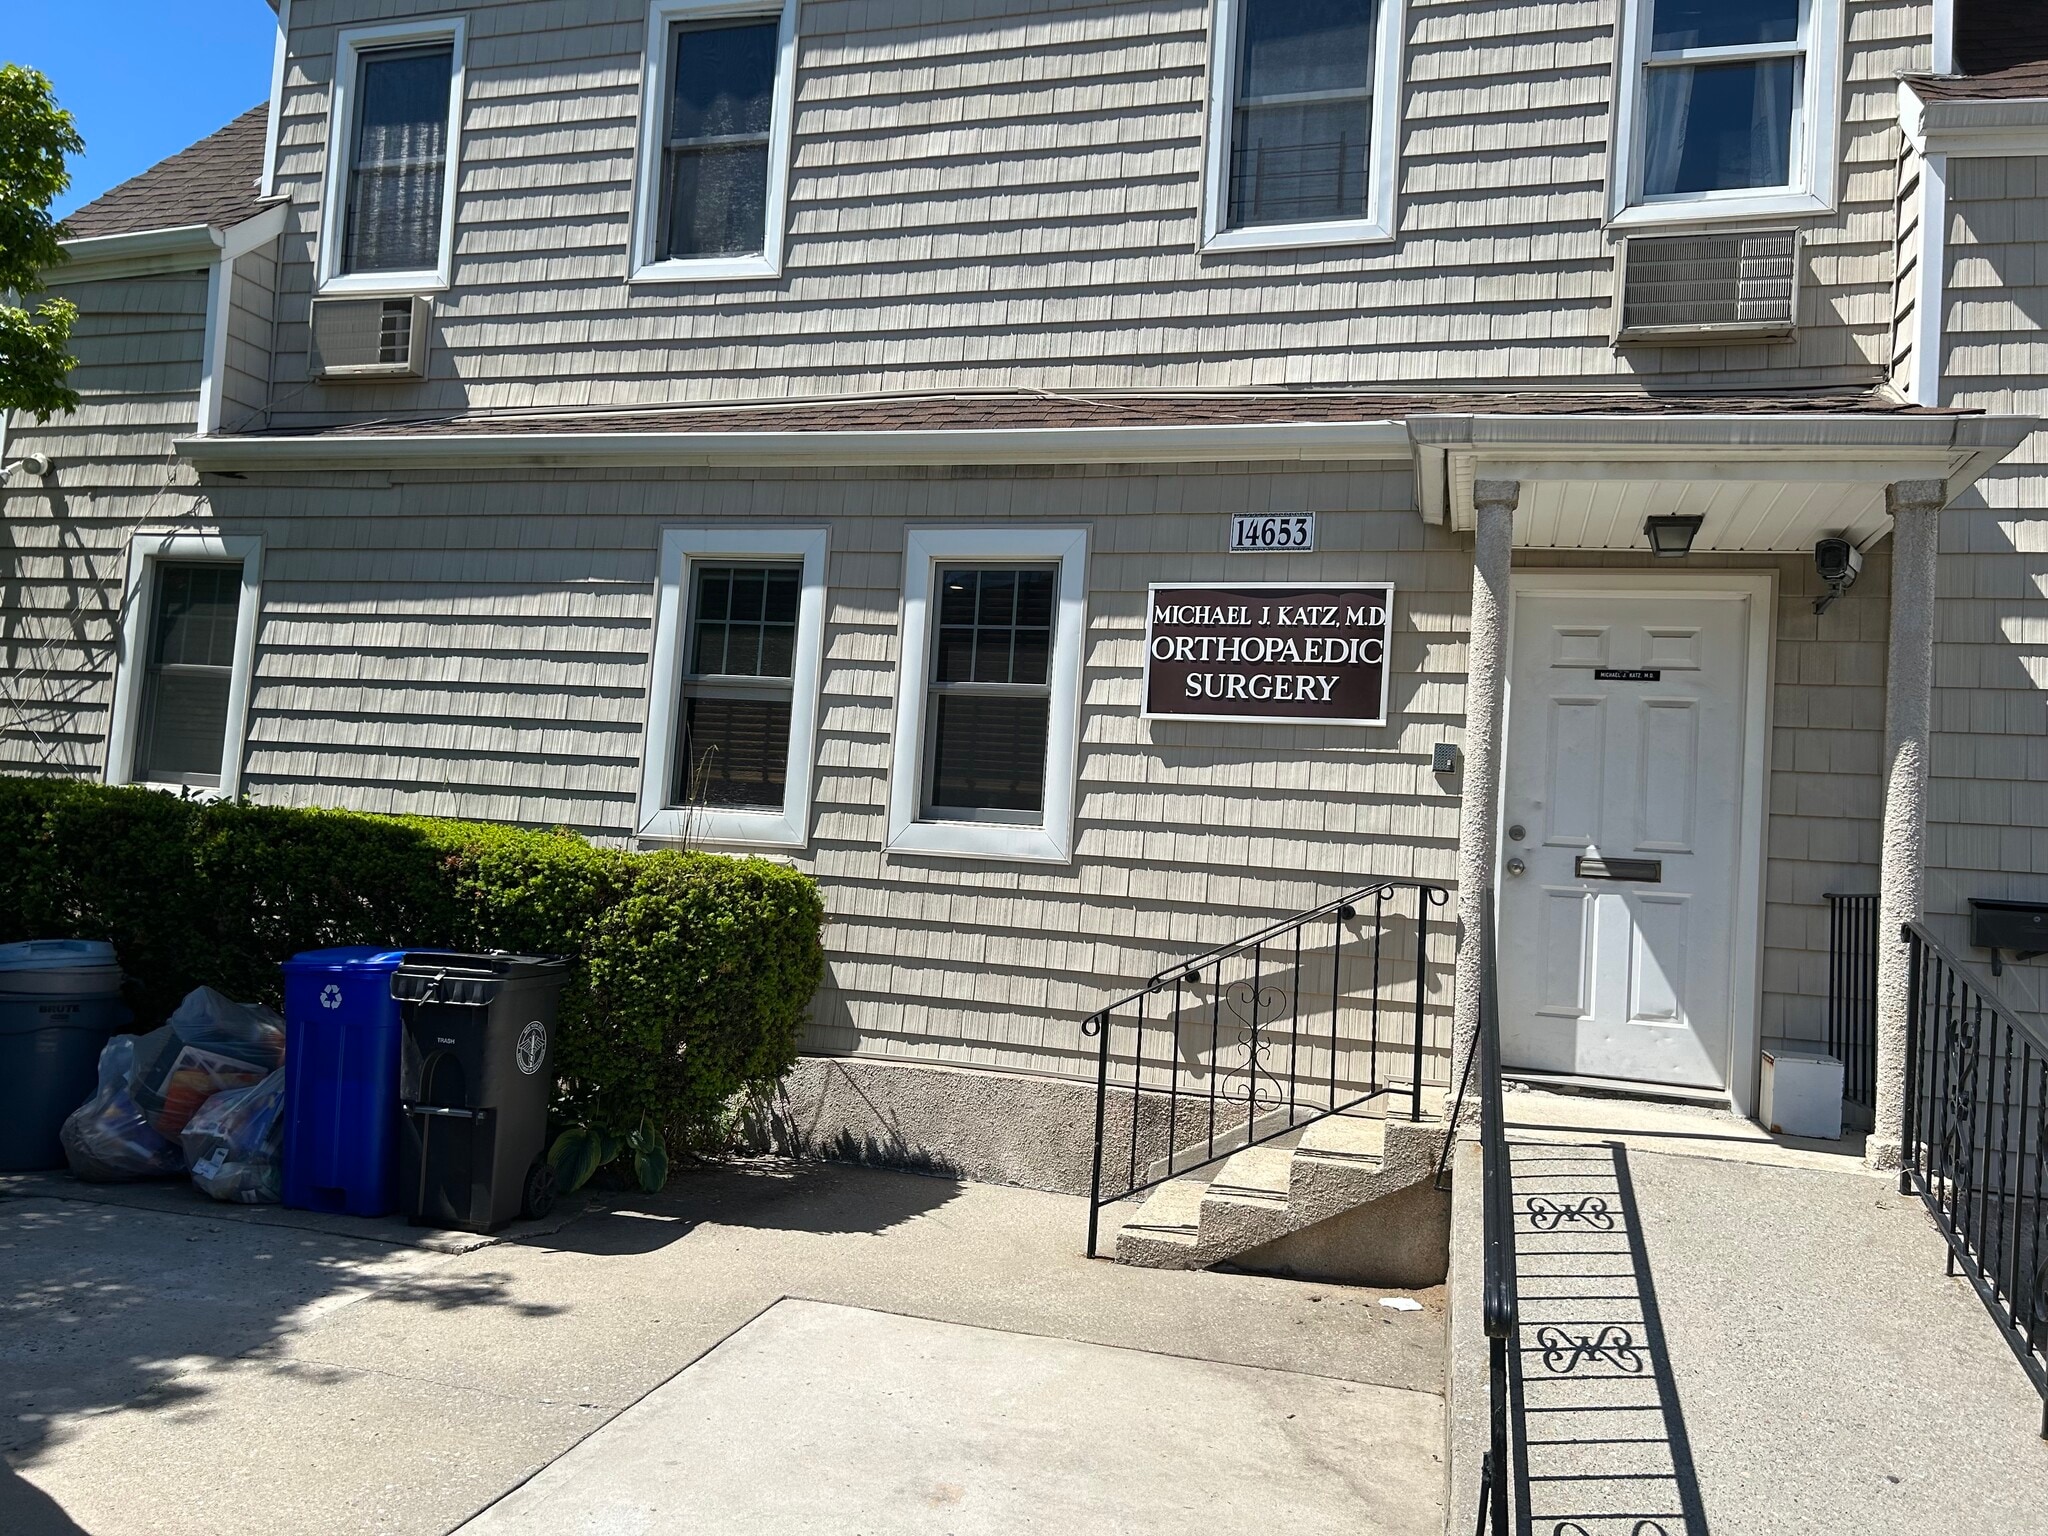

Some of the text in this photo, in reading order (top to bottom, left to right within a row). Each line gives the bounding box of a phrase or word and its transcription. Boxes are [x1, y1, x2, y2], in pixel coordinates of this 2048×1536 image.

[1236, 518, 1307, 546] 14653
[1153, 605, 1387, 628] MICHAEL J. KATZ, M.D.
[1151, 636, 1384, 664] ORTHOPAEDIC
[1185, 672, 1340, 701] SURGERY
[39, 1004, 80, 1013] BRUTE
[437, 1037, 456, 1045] TRASH
